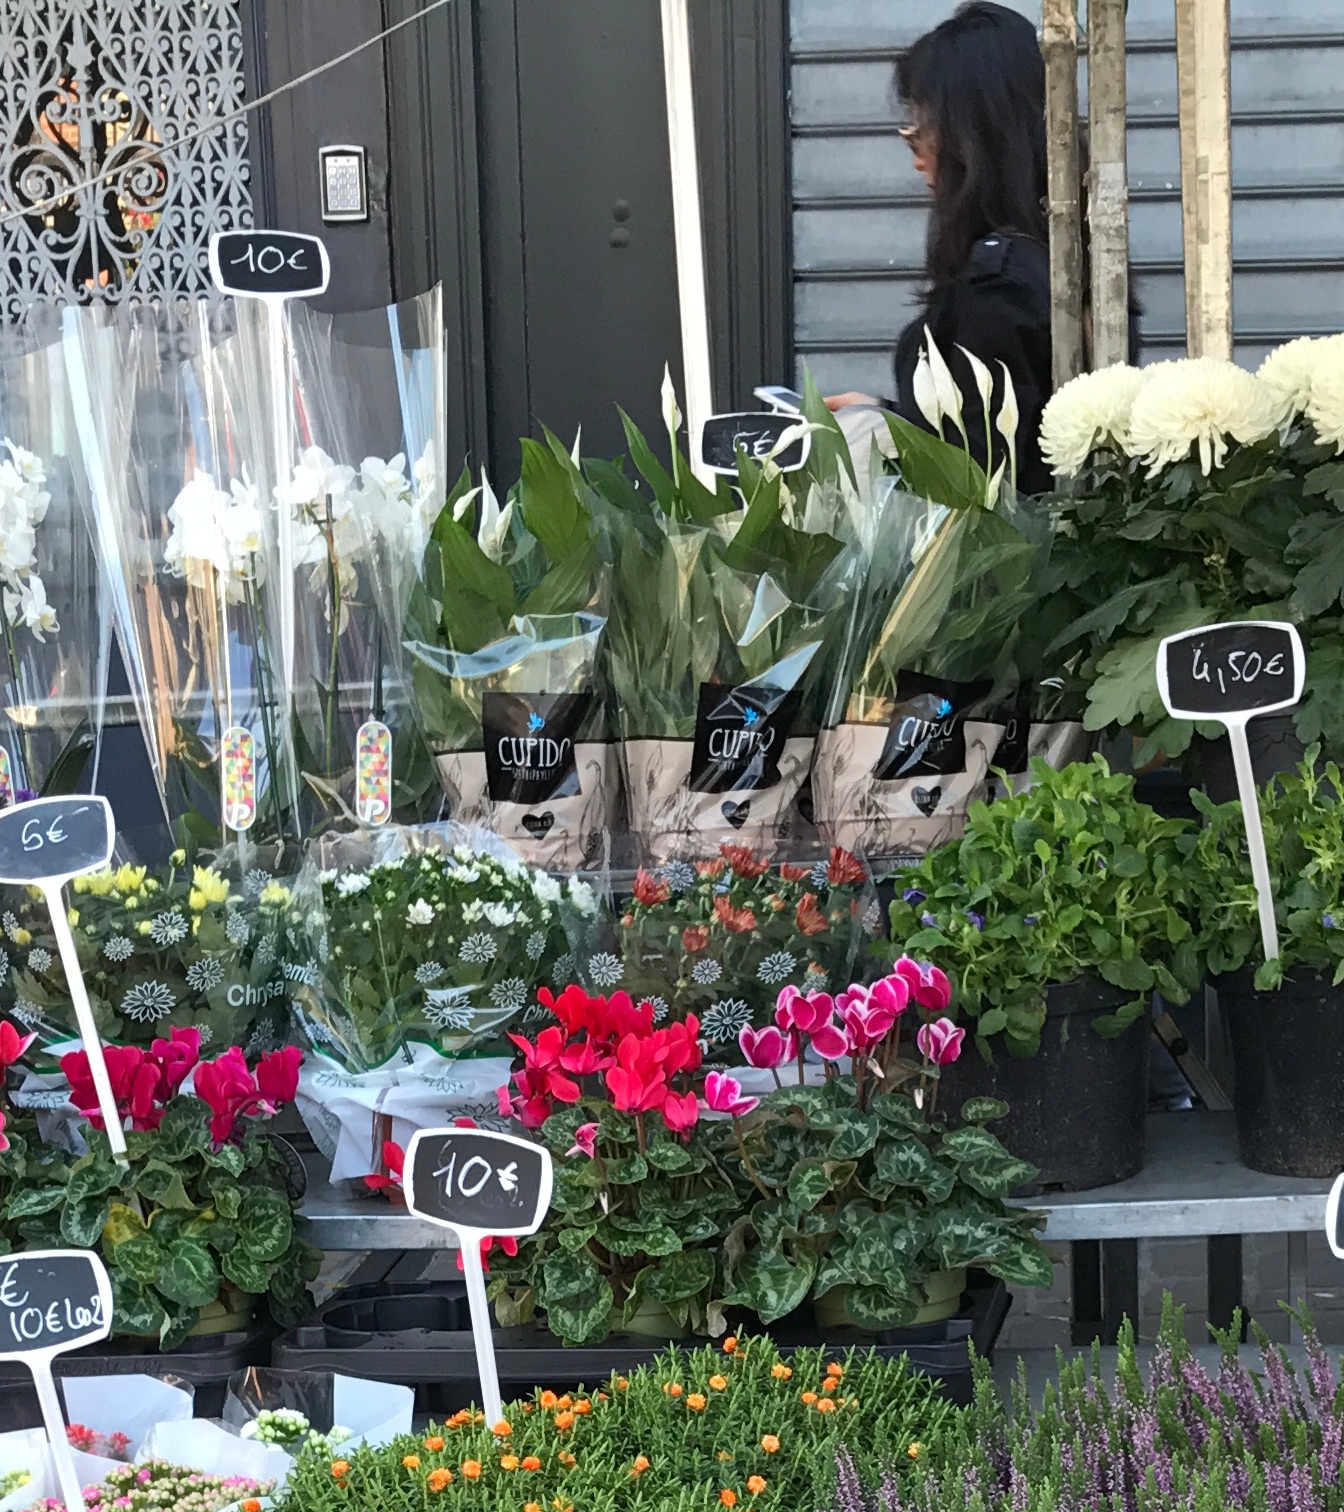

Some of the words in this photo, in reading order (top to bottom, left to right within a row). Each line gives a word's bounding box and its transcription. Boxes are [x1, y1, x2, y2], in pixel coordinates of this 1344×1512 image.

[230, 242, 308, 274] 10€
[1191, 647, 1285, 694] 4,50€
[21, 814, 70, 852] 5€
[431, 1151, 519, 1198] 10€
[9, 1300, 64, 1343] 10€
